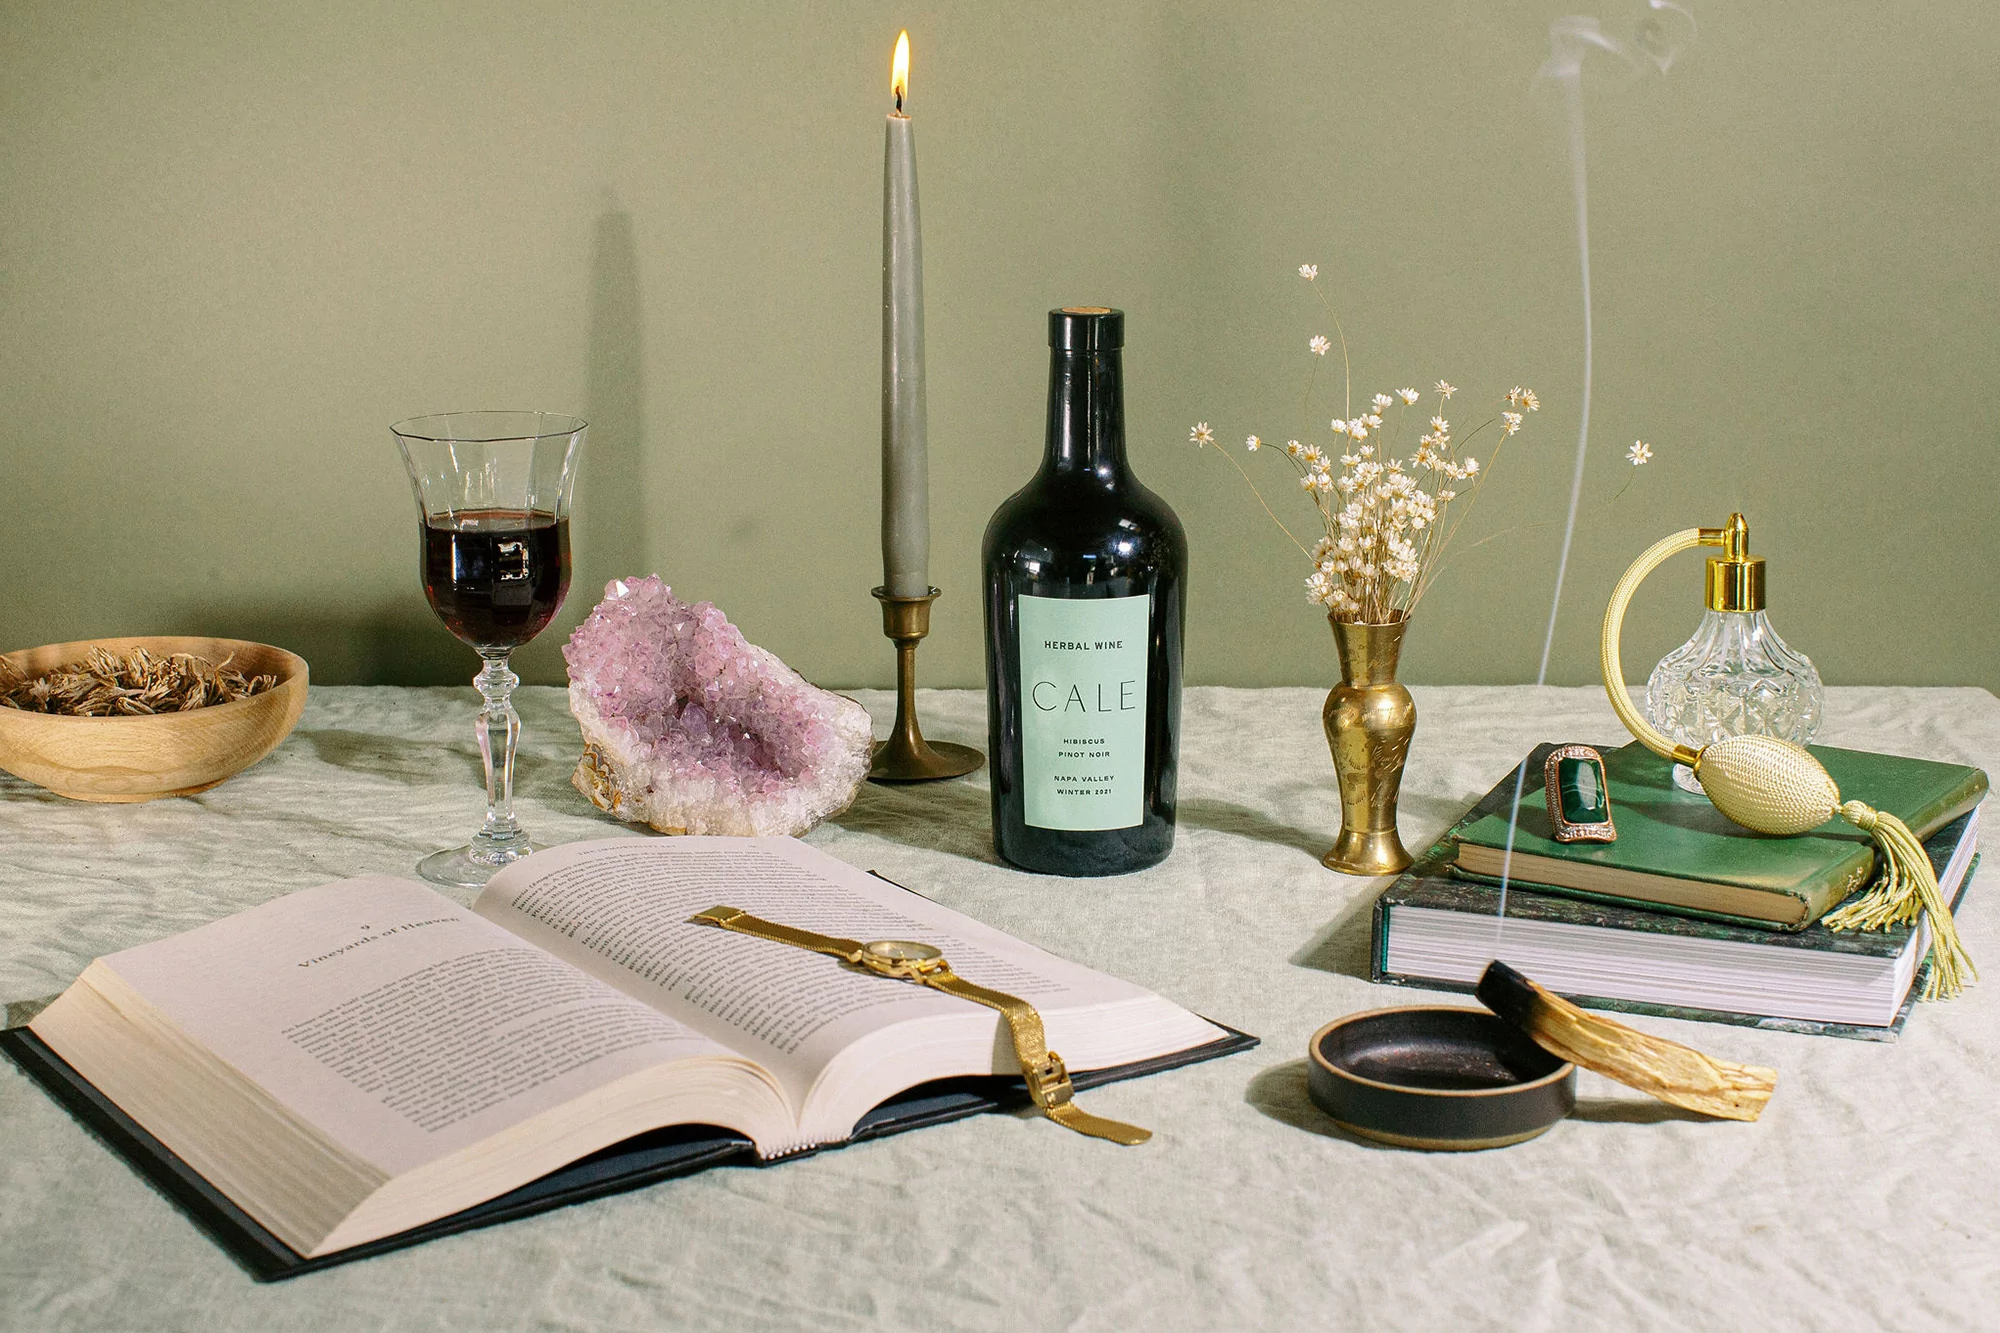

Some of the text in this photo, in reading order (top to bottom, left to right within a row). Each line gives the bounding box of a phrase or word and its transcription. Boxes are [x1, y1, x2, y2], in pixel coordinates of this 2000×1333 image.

[1044, 640, 1123, 651] HERBAL WINE
[1032, 680, 1136, 713] CALE
[1081, 774, 1115, 782] VALLEY
[1056, 788, 1091, 796] WINTER
[297, 917, 461, 968] Vineyards of Heaven
